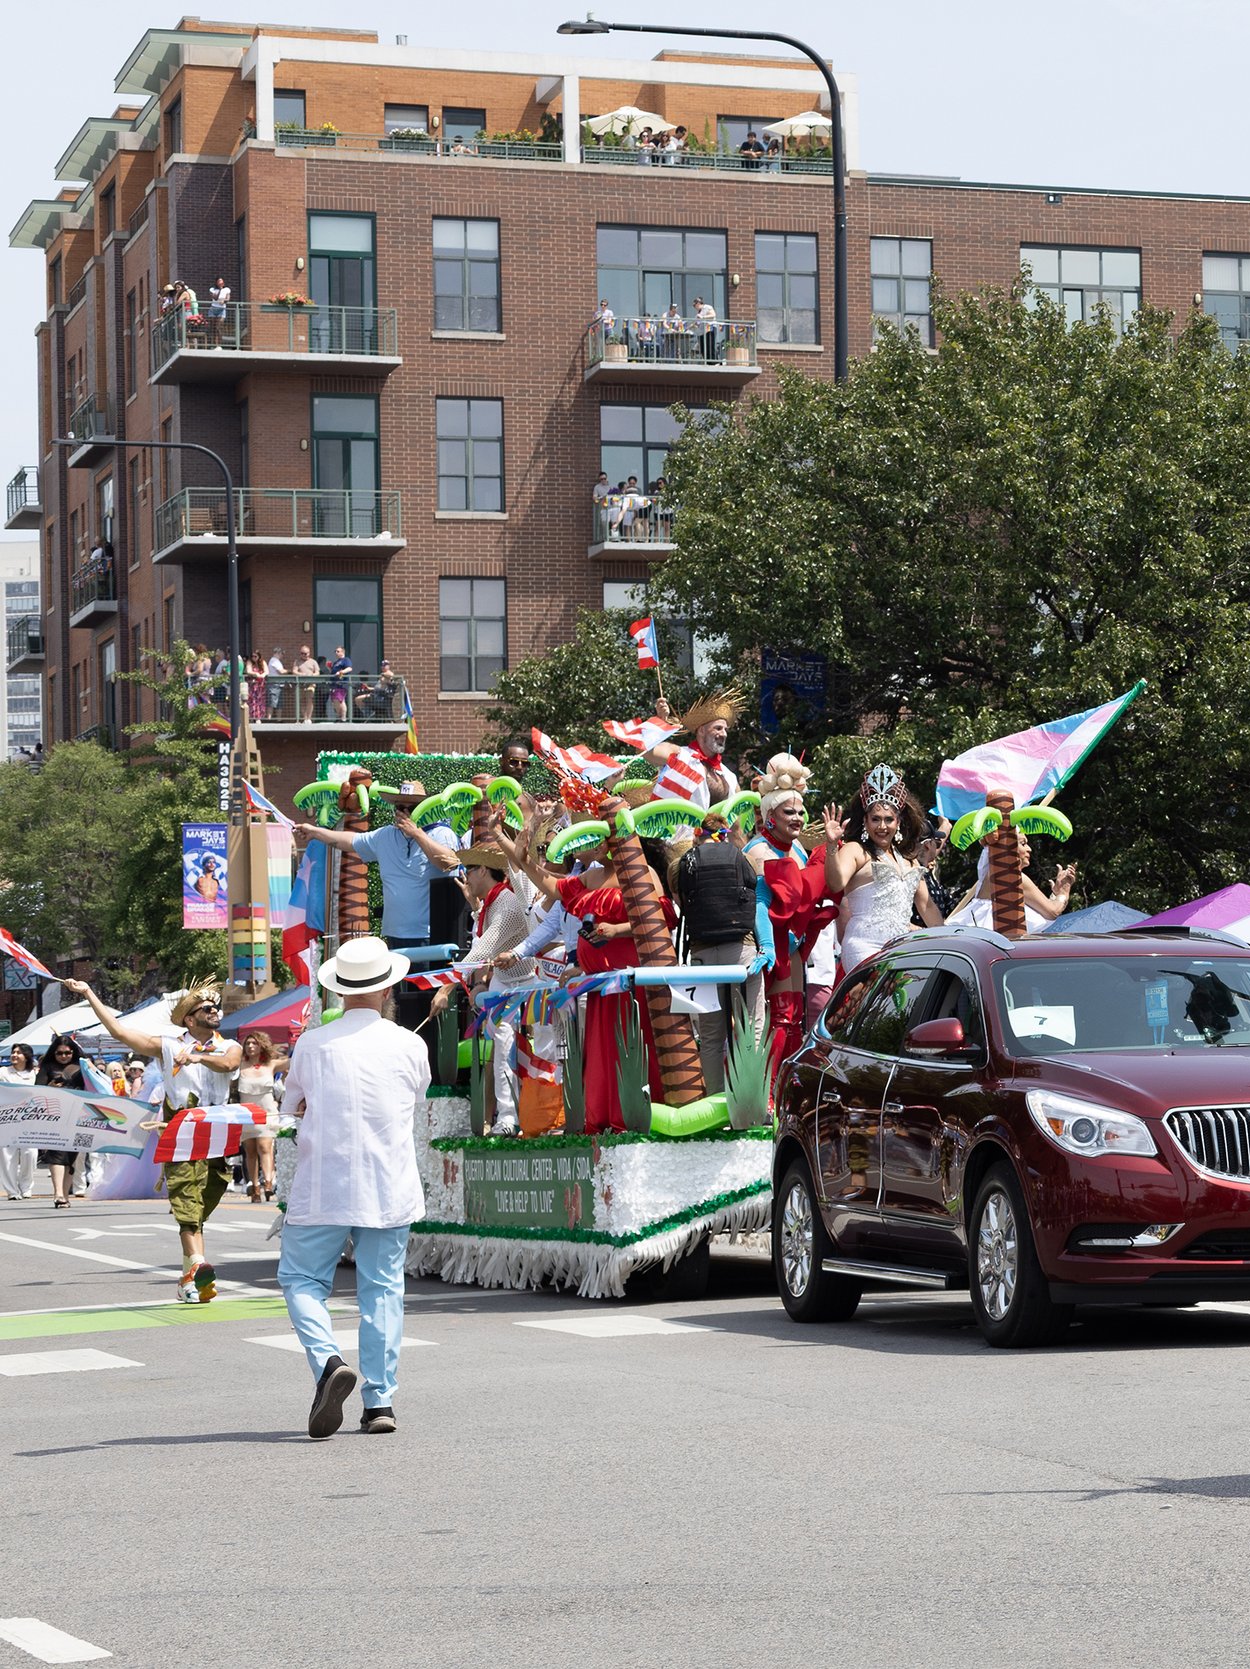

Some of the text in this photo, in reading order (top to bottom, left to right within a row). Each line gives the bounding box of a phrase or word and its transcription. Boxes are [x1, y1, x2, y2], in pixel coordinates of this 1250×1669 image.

[766, 662, 824, 671] MARKET
[790, 672, 823, 681] DAYS
[219, 742, 230, 811] HA3625
[542, 961, 563, 975] CHICAG
[685, 986, 696, 1001] 7
[1034, 1016, 1048, 1025] 7
[21, 1114, 61, 1122] CENTER
[465, 1159, 484, 1181] PUERTO
[485, 1159, 502, 1181] RICAN
[503, 1159, 529, 1181] CULTURAL
[532, 1158, 553, 1181] CENTER
[557, 1157, 571, 1181] VIDA
[530, 1191, 538, 1213] TO
